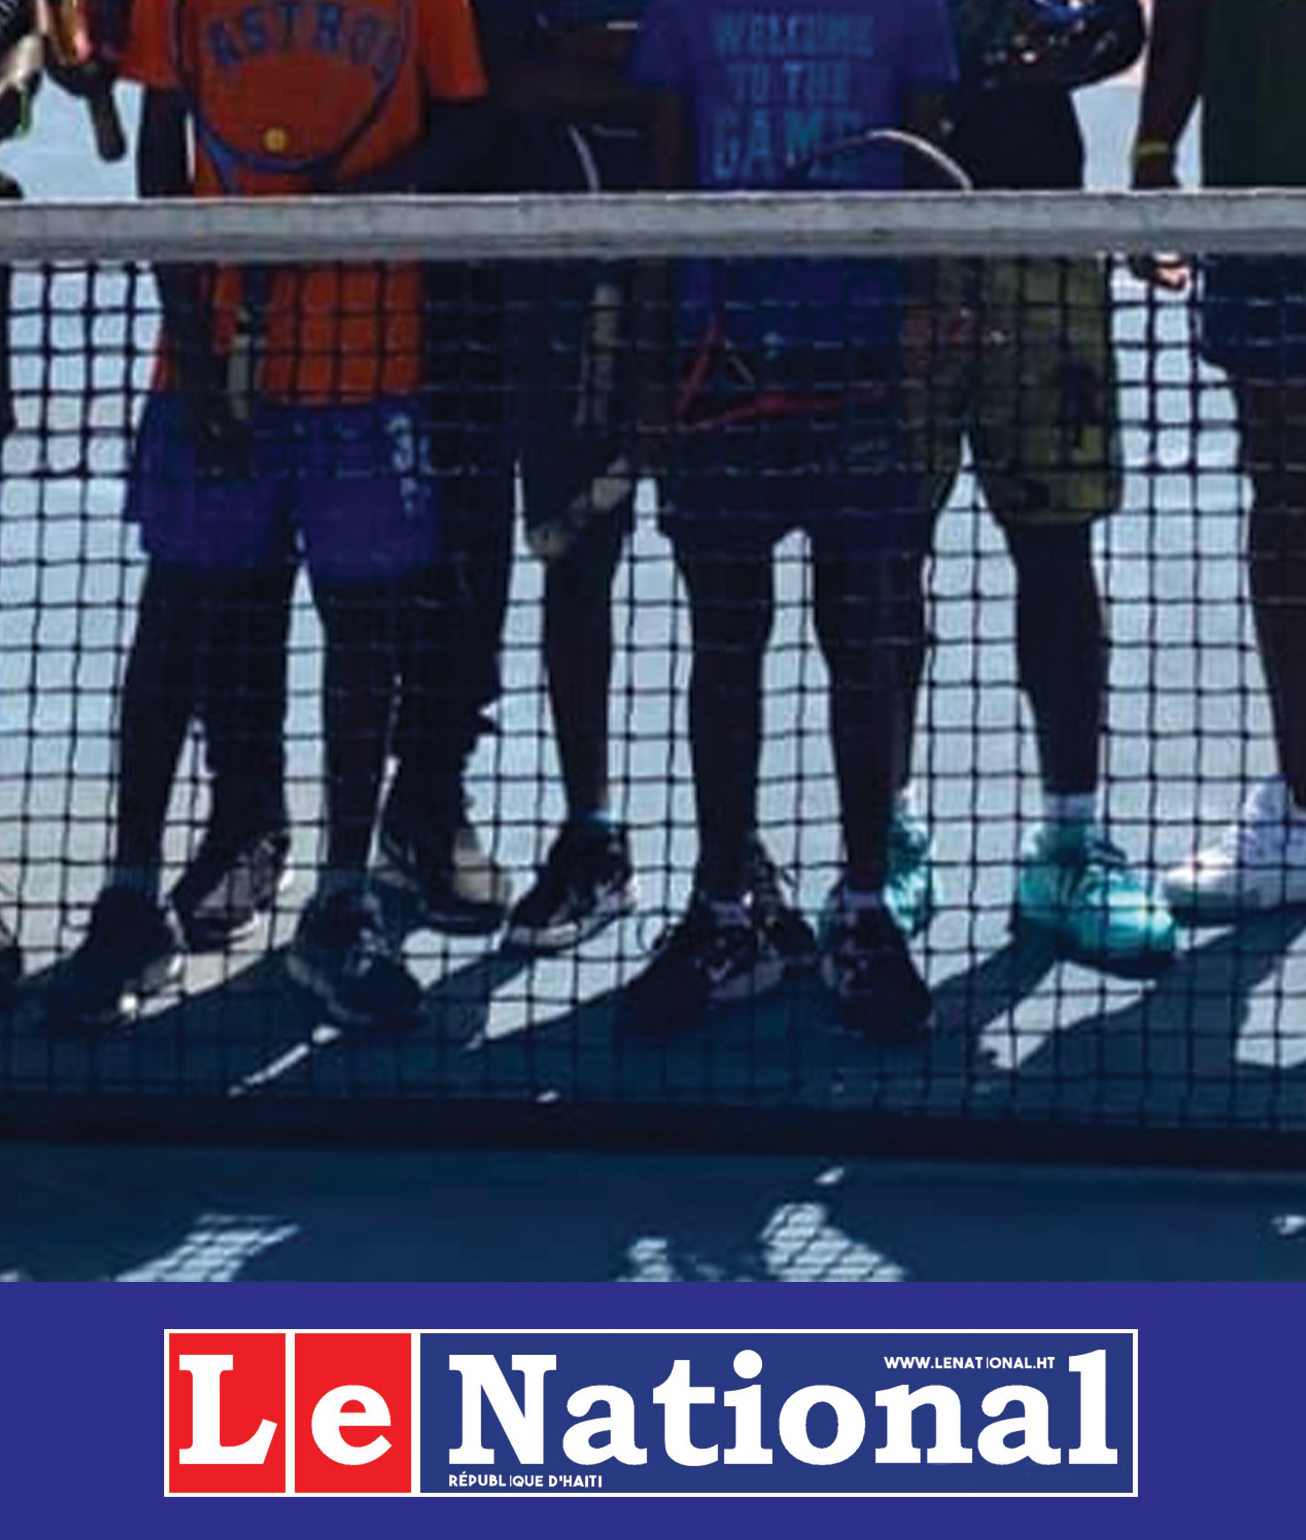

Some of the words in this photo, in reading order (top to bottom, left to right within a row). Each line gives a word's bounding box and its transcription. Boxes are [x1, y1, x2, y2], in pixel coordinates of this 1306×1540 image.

[711, 11, 875, 58] WELCOME
[726, 61, 770, 105] TO
[782, 61, 851, 105] THE
